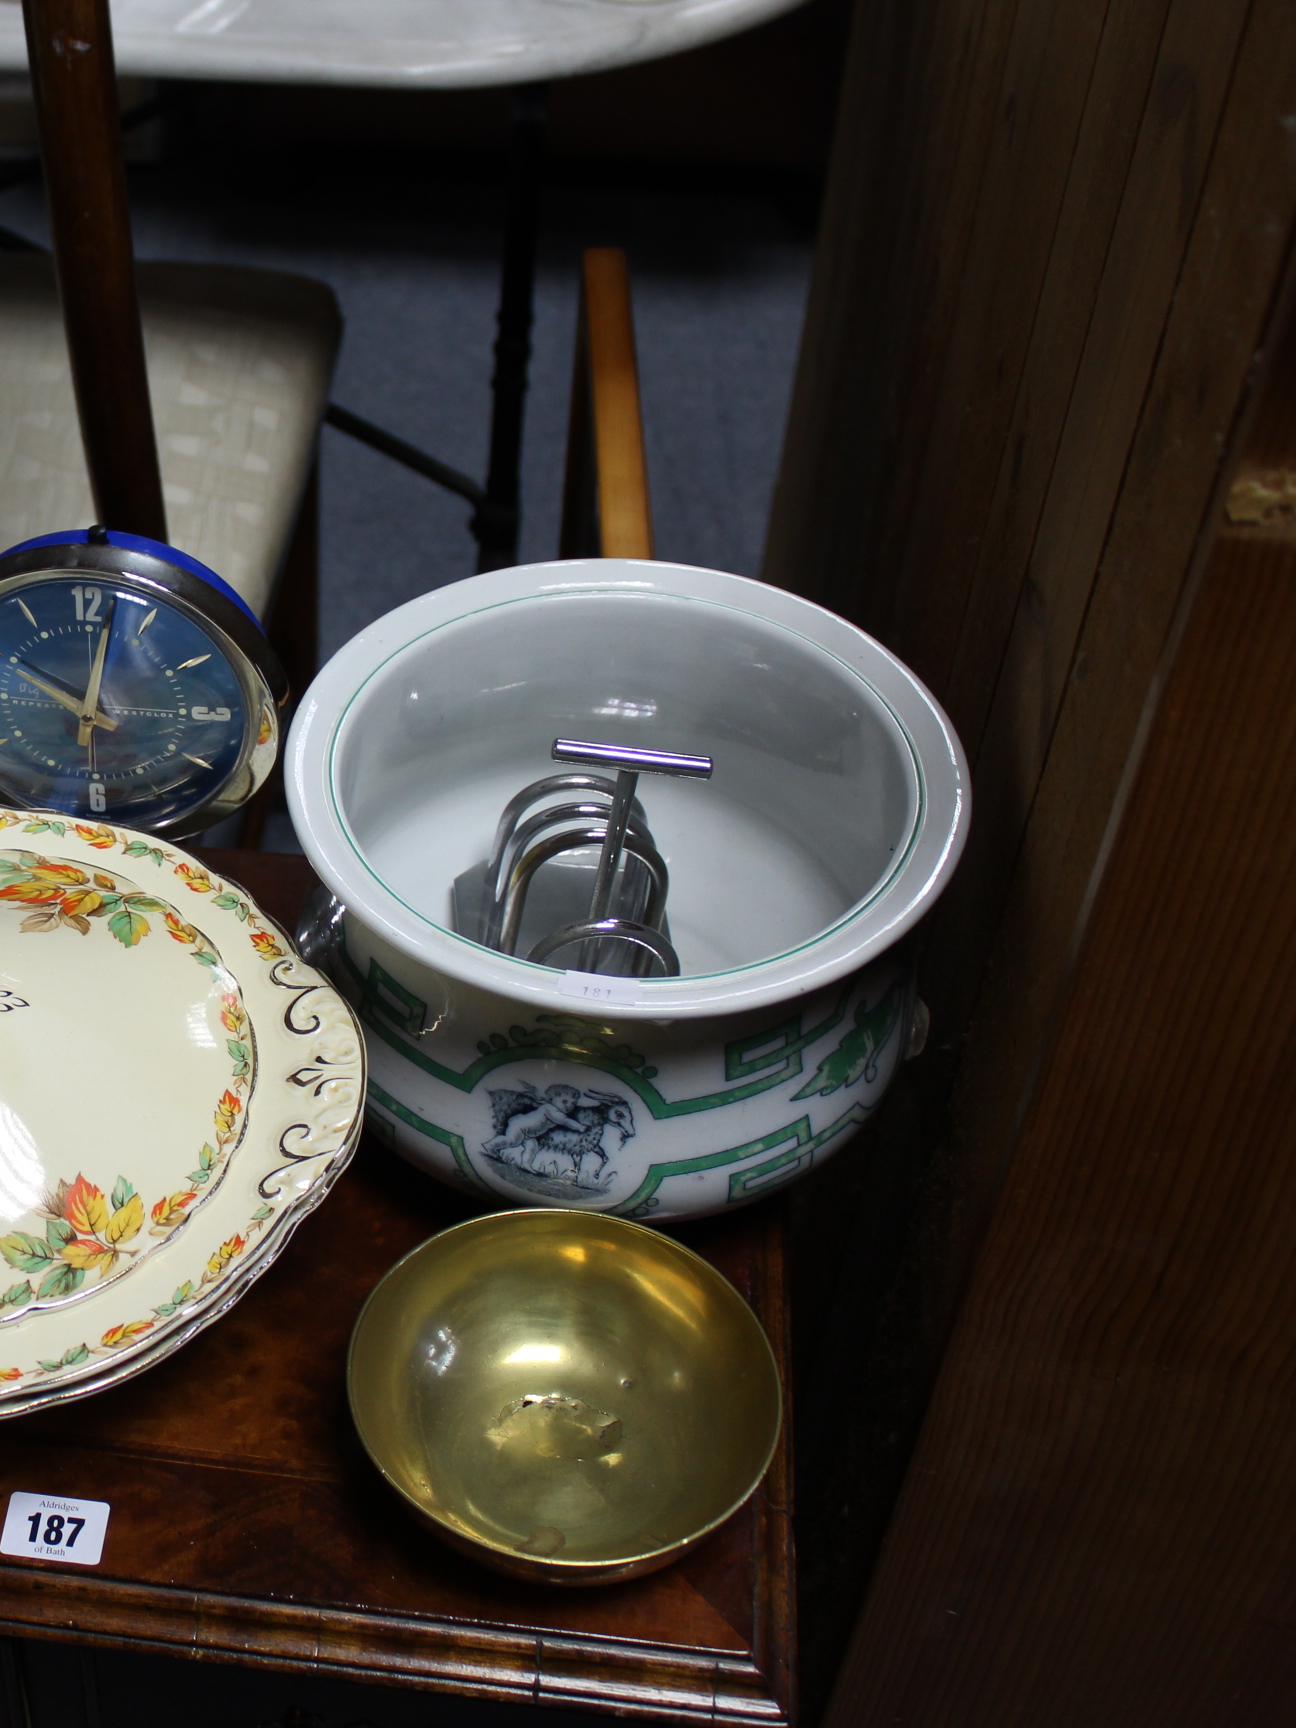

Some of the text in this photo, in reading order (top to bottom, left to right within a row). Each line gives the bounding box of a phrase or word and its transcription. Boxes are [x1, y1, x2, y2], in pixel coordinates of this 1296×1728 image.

[71, 585, 103, 622] 12
[12, 700, 66, 710] REPEATE
[112, 708, 174, 719] WESTCLOX
[191, 706, 231, 722] 3
[89, 782, 106, 813] 6
[582, 986, 613, 999] 181
[39, 1500, 80, 1512] Aldridges
[27, 1511, 86, 1548] 187
[34, 1546, 66, 1557] of Bath
